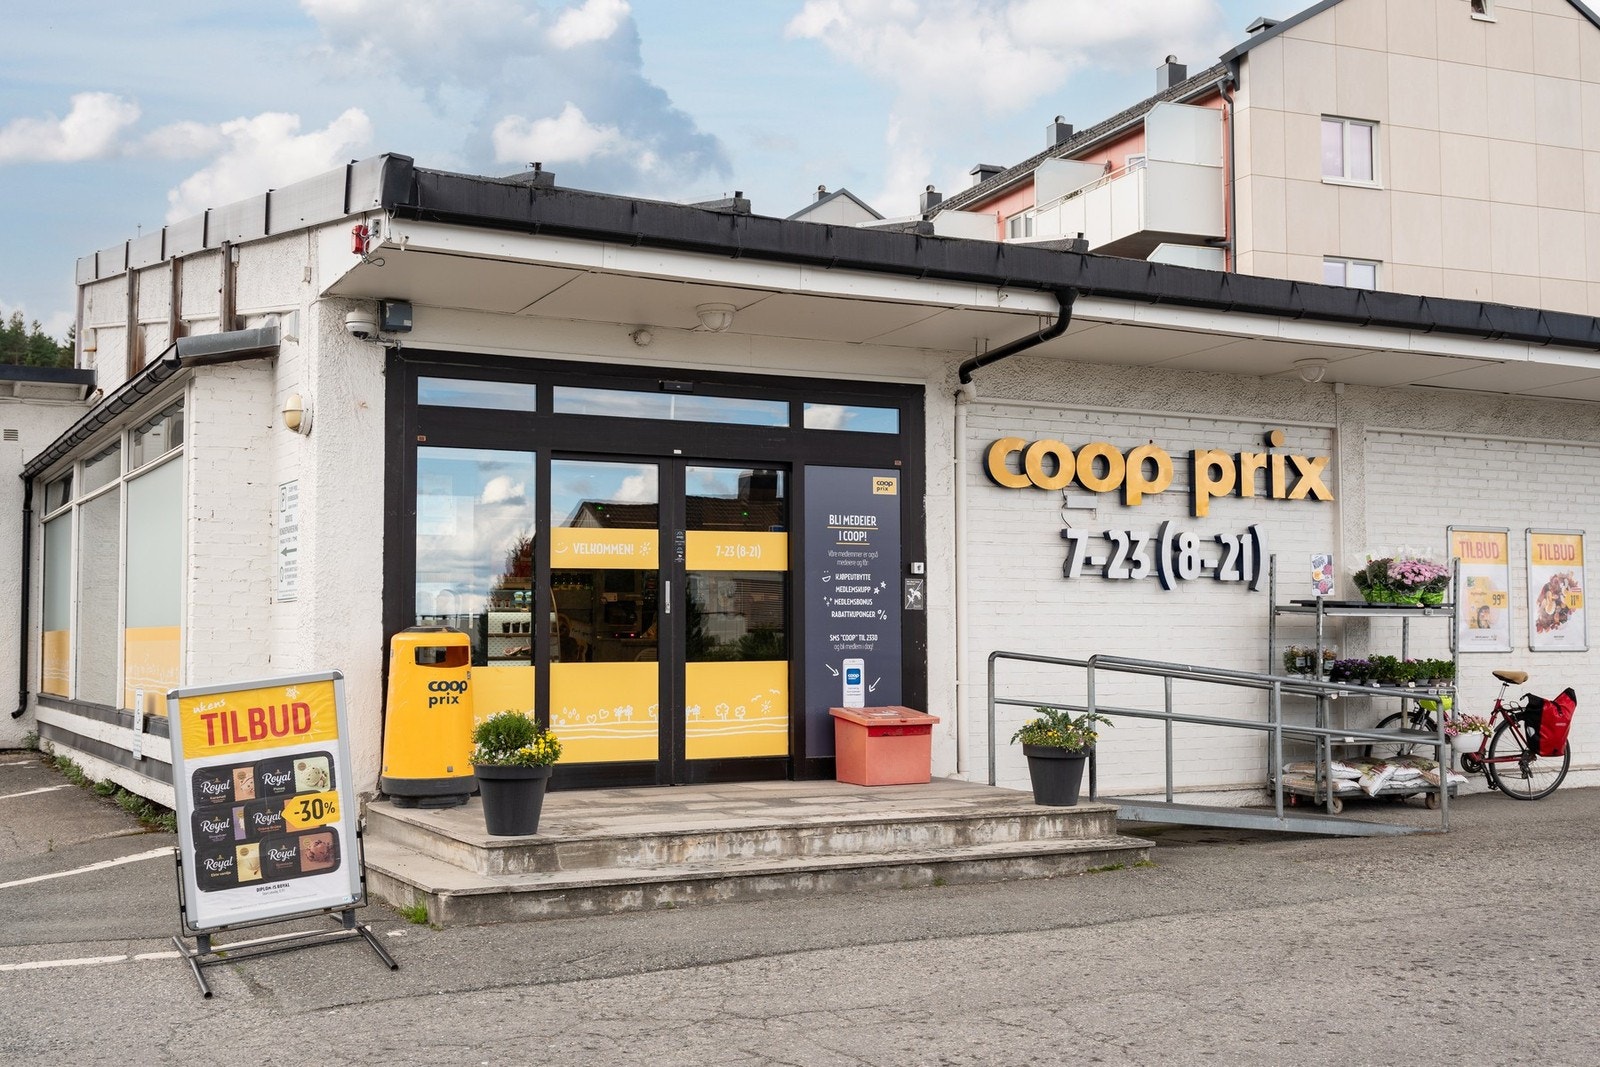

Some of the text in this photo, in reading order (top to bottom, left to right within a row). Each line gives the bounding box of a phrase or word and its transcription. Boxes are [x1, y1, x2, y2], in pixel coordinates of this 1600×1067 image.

[984, 429, 1334, 518] coop prix
[829, 514, 877, 526] BLI MEDEIER
[838, 530, 867, 542] I COOP!
[573, 543, 634, 556] VELKOMMEN!
[715, 545, 761, 558] 7-23 (8-21)
[1061, 520, 1268, 592] 7-23 (8-21)
[1459, 540, 1500, 559] TILBUD
[1537, 543, 1576, 561] TILBUD
[835, 573, 871, 581] KJØPEUTBYTTE
[834, 598, 873, 606] MEDLEMSBONUS
[840, 634, 858, 642] "COOP"
[428, 680, 468, 694] coop
[193, 698, 226, 714] ukens
[429, 692, 459, 708] prix
[200, 701, 312, 746] TILBUD
[261, 771, 292, 786] Royal
[200, 779, 231, 795] Royal
[294, 797, 336, 822] -30%
[200, 818, 230, 834] Royal
[252, 810, 282, 826] Royal
[267, 846, 297, 862] Royal
[203, 856, 234, 872] Royal
